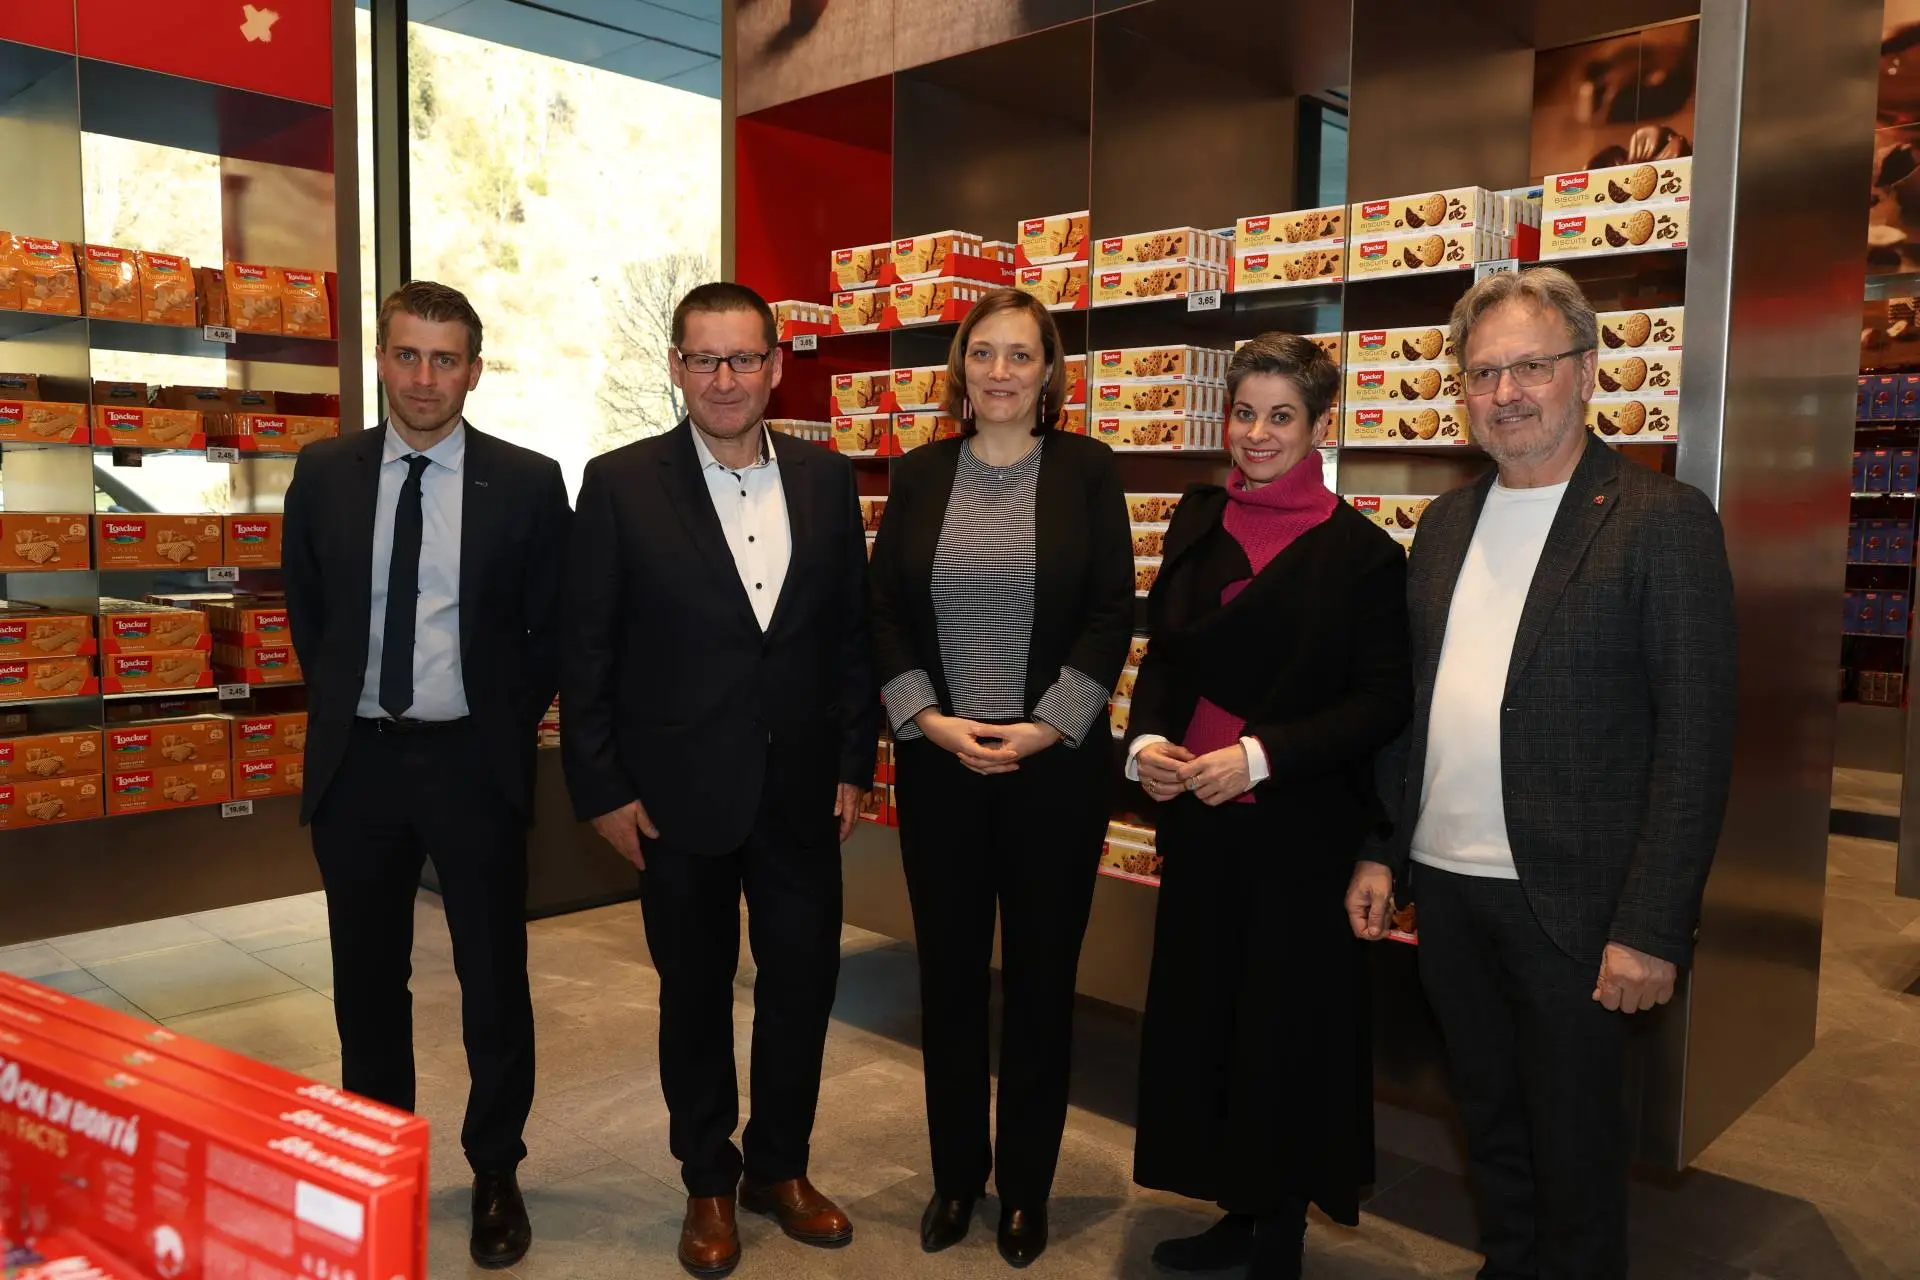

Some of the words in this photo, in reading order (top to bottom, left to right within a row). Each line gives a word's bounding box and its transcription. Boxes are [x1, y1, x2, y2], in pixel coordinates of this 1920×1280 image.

[1558, 177, 1585, 186] Loacker
[1554, 194, 1589, 204] BISCUITS
[1364, 205, 1387, 214] Loacker
[1556, 220, 1583, 230] Loacker
[1552, 238, 1587, 247] BISCUITS
[1362, 244, 1385, 253] Loacker
[1361, 334, 1384, 343] Loacker
[1360, 373, 1382, 381] Loacker
[0, 405, 20, 414] cker
[107, 411, 140, 421] Loacker
[1358, 412, 1381, 420] Loacker
[255, 419, 284, 428] Loacker
[1356, 499, 1378, 507] Loacker
[105, 523, 143, 534] Loacker
[234, 524, 268, 534] Loacker
[256, 615, 286, 624] Loacker
[0, 625, 23, 633] acker
[116, 620, 148, 630] Loacker
[257, 652, 286, 661] Loacker
[117, 658, 150, 669] Loacker
[0, 665, 25, 675] acker
[241, 723, 273, 733] Loacker
[113, 733, 149, 745] Loacker
[243, 762, 274, 773] Loacker
[115, 775, 151, 786] Loacker
